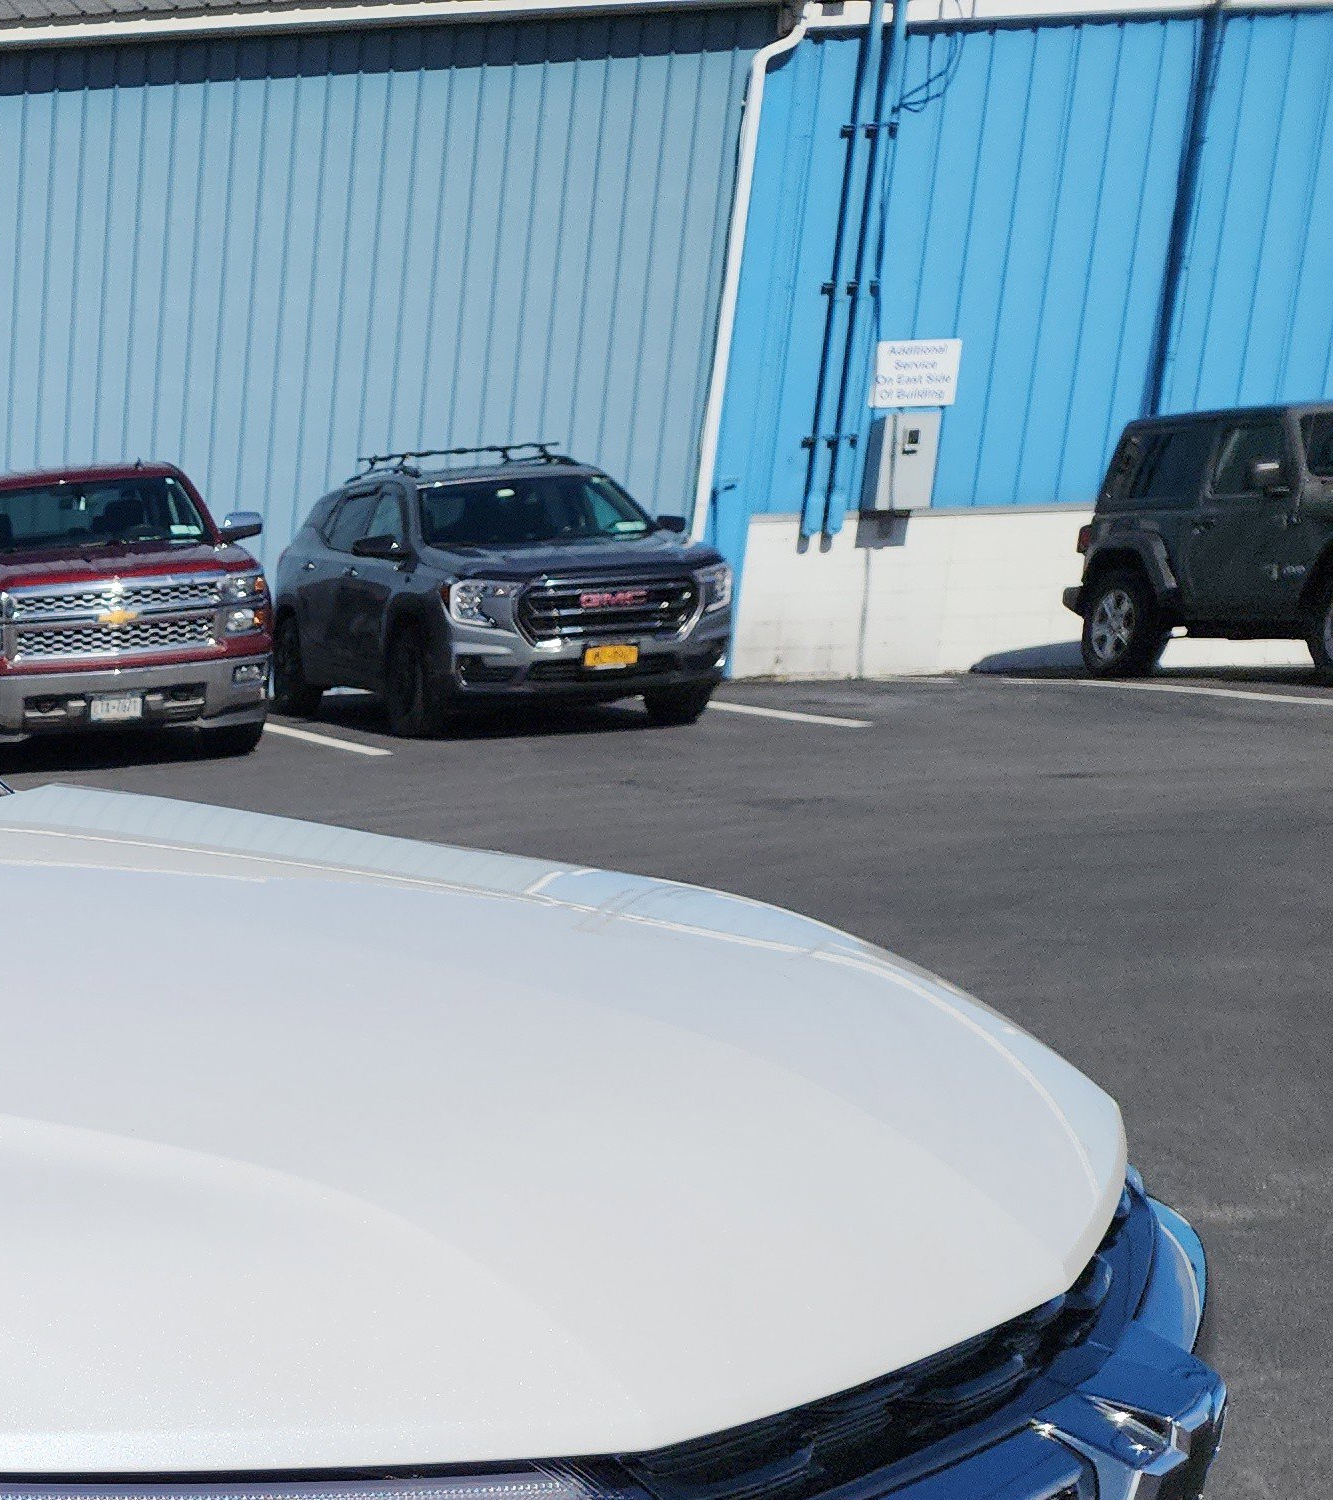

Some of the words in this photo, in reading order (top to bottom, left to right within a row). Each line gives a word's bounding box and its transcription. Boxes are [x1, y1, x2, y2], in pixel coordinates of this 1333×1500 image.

[888, 343, 949, 355] Additional
[893, 360, 938, 370] Service
[875, 375, 894, 386] On
[896, 374, 923, 385] East
[926, 372, 951, 384] Side
[896, 388, 945, 400] Building
[580, 590, 647, 608] GMC
